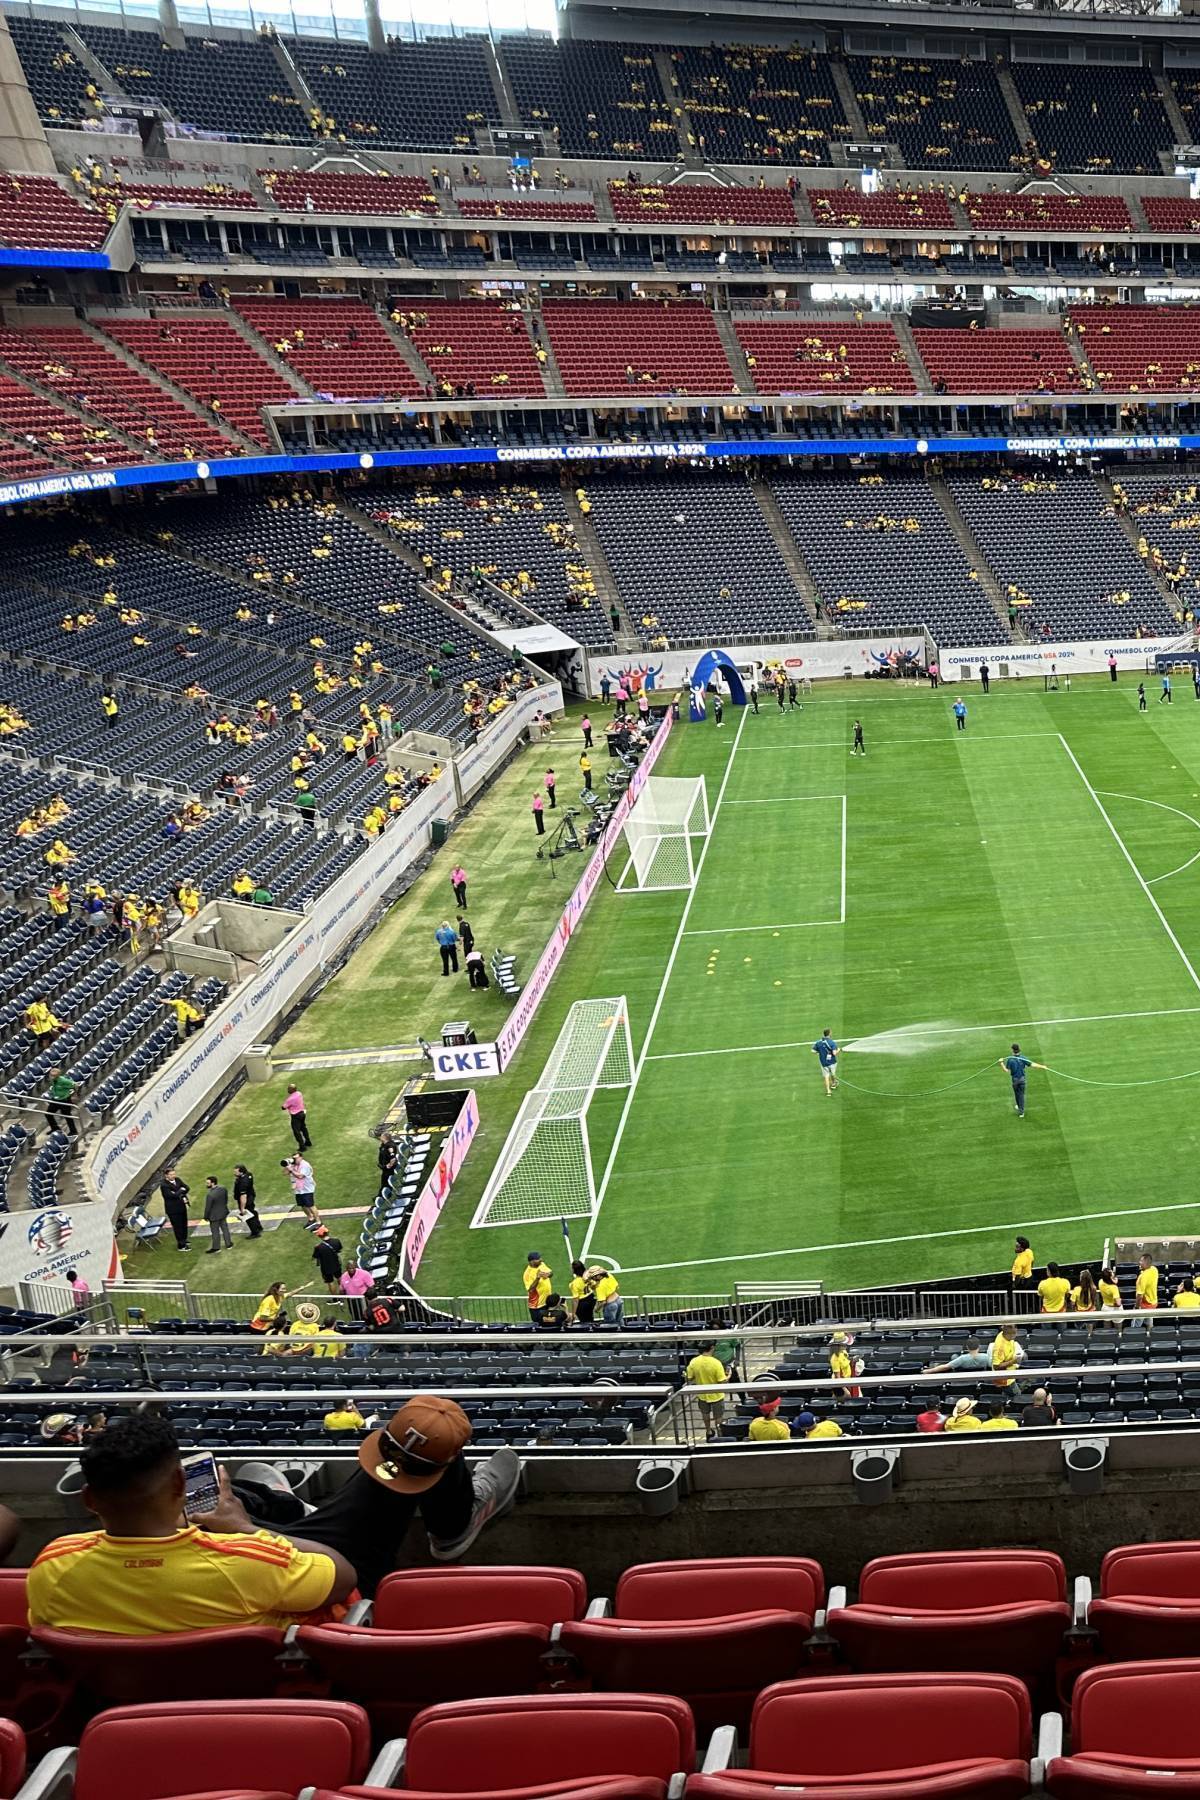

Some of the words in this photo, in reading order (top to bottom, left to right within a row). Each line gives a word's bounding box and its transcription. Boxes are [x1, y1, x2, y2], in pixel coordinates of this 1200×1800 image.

[497, 448, 566, 460] CONMEBOL
[566, 447, 600, 458] COPA
[600, 446, 653, 458] AMERICA
[654, 445, 678, 456] USA
[678, 444, 706, 456] 2024
[1006, 438, 1063, 450] CONMEBOL
[1064, 438, 1092, 449] COPA
[1092, 438, 1136, 448] AMERICA
[1137, 437, 1156, 448] USA
[1156, 436, 1180, 447] 2024
[20, 482, 40, 498] COPA
[40, 478, 72, 496] AMERICA
[72, 475, 91, 490] USA
[91, 472, 117, 488] 2024
[948, 656, 989, 664] CONMEBOL
[162, 1068, 191, 1103] CONMEBOL
[190, 1055, 204, 1072] COPA
[204, 1032, 224, 1058] AMERICA
[222, 1022, 233, 1037] USA
[232, 1011, 244, 1026] 2024
[438, 1051, 492, 1073] CKE
[128, 1125, 142, 1143] USA
[140, 1110, 153, 1130] 2024
[24, 1267, 49, 1281] COPA
[50, 1249, 91, 1270] AMERICA
[42, 1273, 57, 1281] USA
[59, 1264, 76, 1274] 2024
[374, 1307, 390, 1325] 10
[320, 1344, 328, 1356] 7
[405, 1426, 428, 1449] T
